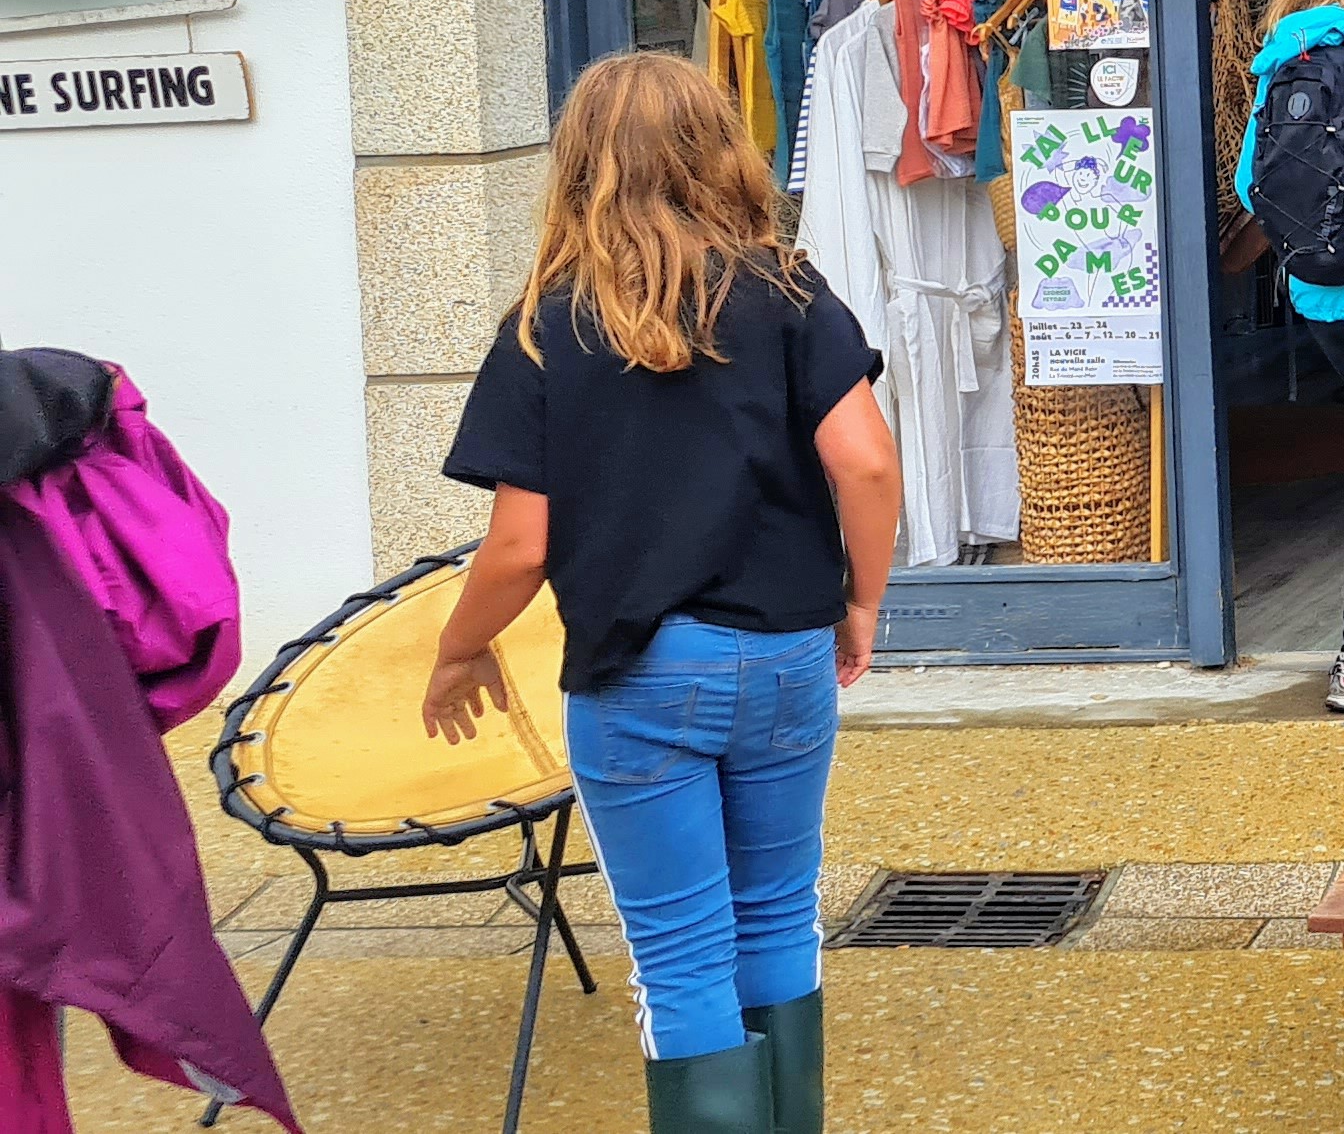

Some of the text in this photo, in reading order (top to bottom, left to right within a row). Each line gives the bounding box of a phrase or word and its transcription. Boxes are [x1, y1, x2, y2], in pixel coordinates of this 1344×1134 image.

[50, 65, 216, 113] SURFING
[1029, 322, 1058, 332] juillet
[1103, 331, 1113, 339] 12
